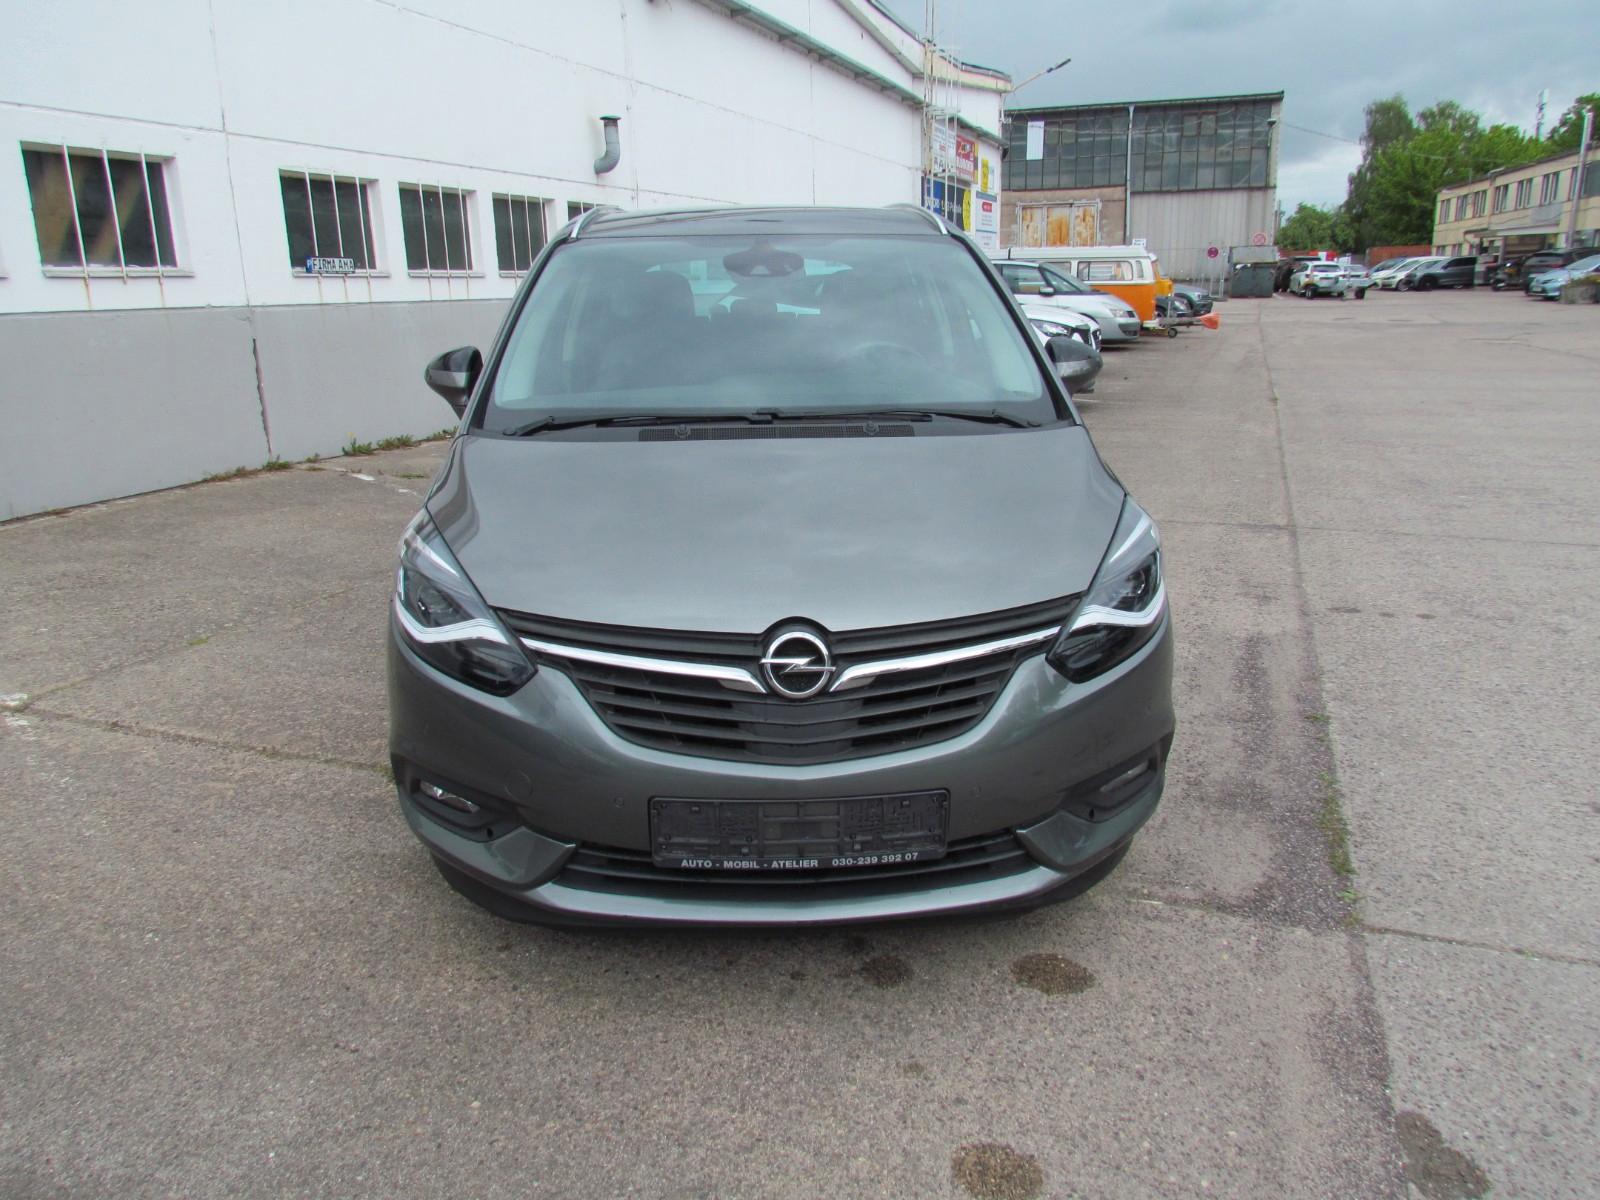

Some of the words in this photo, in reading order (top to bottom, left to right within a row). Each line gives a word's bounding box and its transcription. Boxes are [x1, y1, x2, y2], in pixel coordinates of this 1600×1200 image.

[312, 258, 337, 270] FIRMA
[681, 859, 713, 868] AUTO
[723, 860, 760, 869] MOBIL
[771, 860, 819, 868] ATELIER
[832, 856, 878, 867] 030-239
[881, 854, 902, 864] 392
[904, 852, 919, 861] 07
